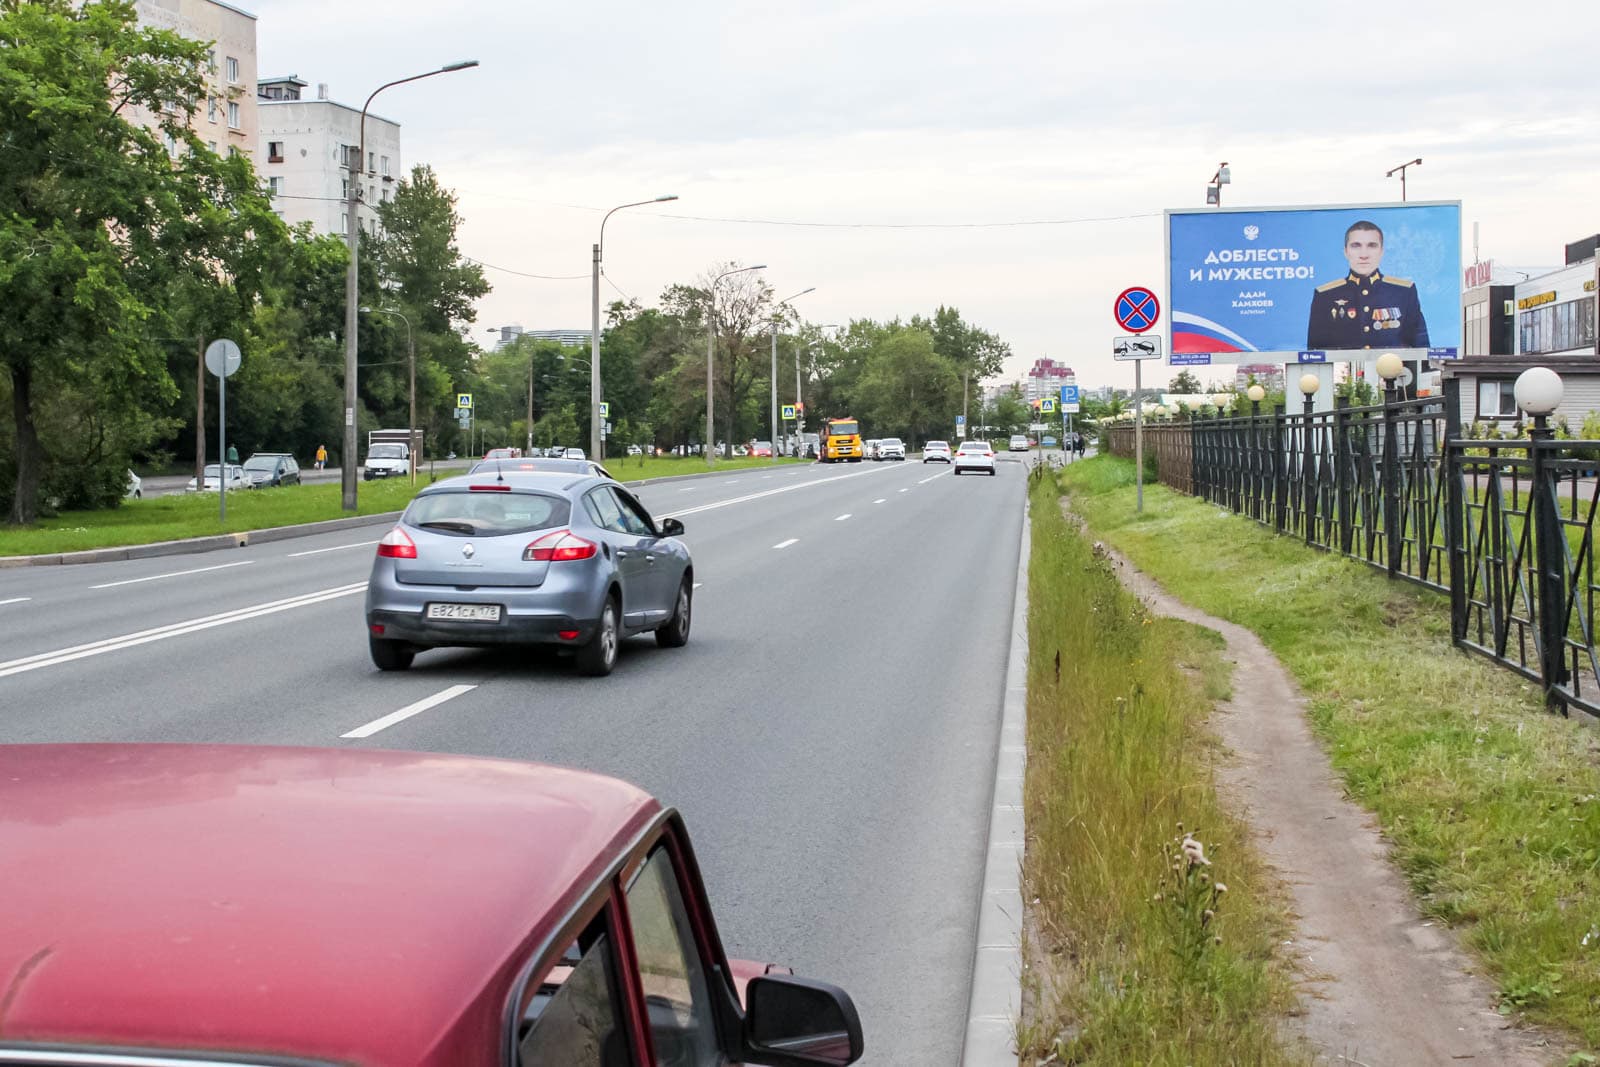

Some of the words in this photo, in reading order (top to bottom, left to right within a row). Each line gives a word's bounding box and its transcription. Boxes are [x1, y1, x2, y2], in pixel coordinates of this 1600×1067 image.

[1204, 248, 1299, 264] ДОБЛЕСТЬ
[1190, 269, 1202, 281] И
[1208, 266, 1315, 281] МУЖЕСТВО!
[1239, 291, 1266, 299] АДАМ
[1231, 300, 1274, 308] ХАМХОЕВ
